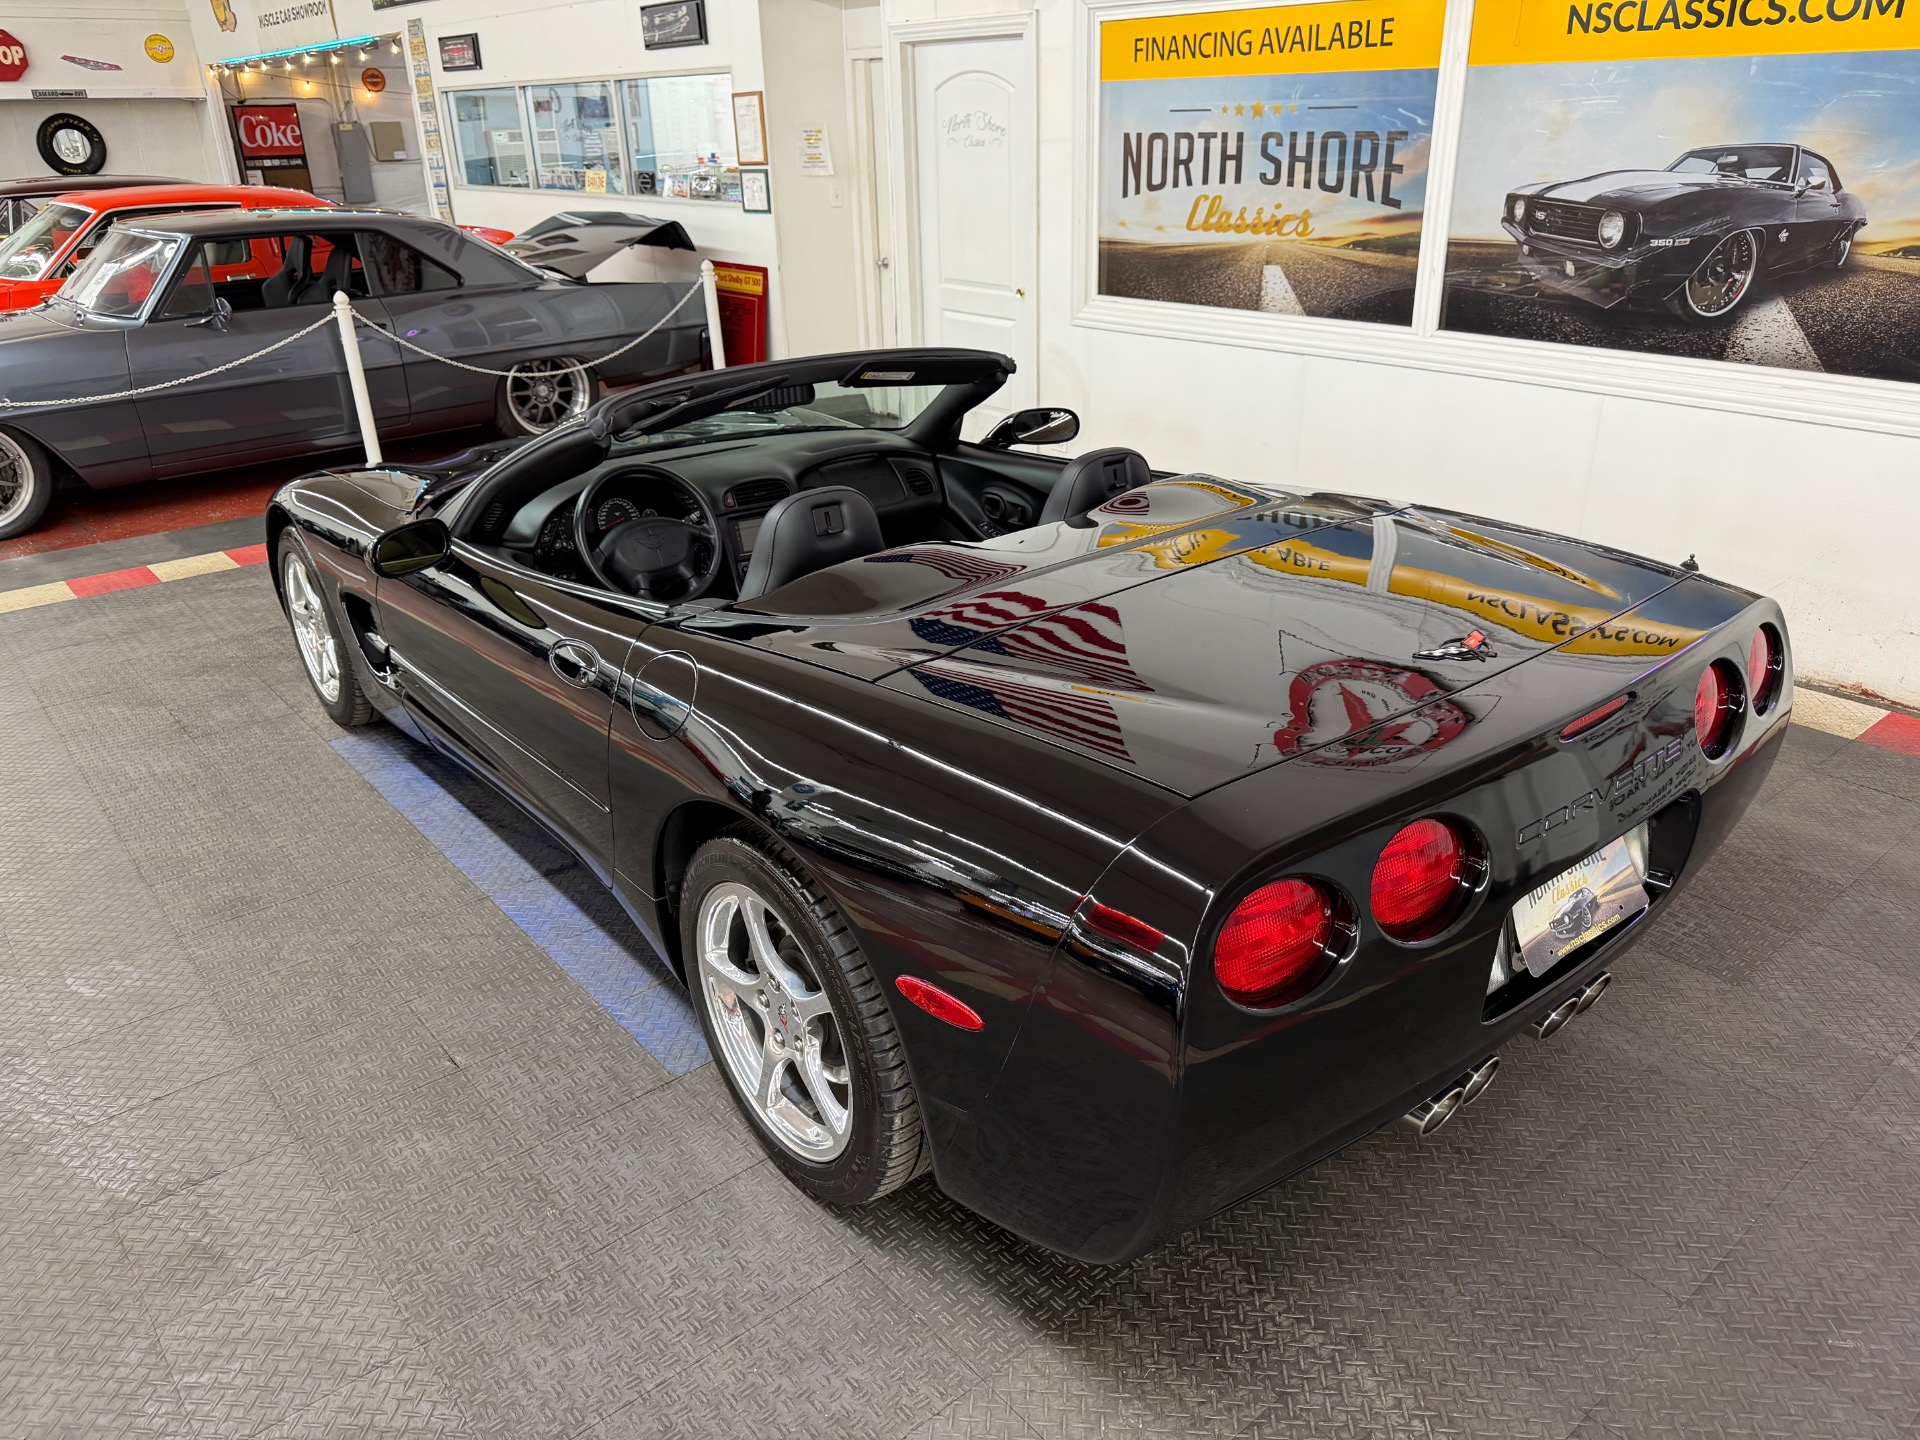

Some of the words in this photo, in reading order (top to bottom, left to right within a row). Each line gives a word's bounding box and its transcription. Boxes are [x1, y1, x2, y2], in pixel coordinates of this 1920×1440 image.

[280, 8, 292, 24] CAR
[1566, 0, 1906, 35] NSCLASSICS.COM
[0, 45, 24, 66] OP
[1133, 29, 1253, 63] FINANCING
[1258, 17, 1395, 55] AVAILABLE
[238, 115, 303, 148] Coke
[1122, 131, 1245, 199] NORTH
[1258, 130, 1409, 211] SHORE
[1185, 193, 1316, 238] Classics
[1649, 239, 1673, 247] 350
[1516, 734, 1684, 850] CORVETTE
[1551, 873, 1590, 905] Classics
[1556, 913, 1621, 957] www.nsclassics.com
